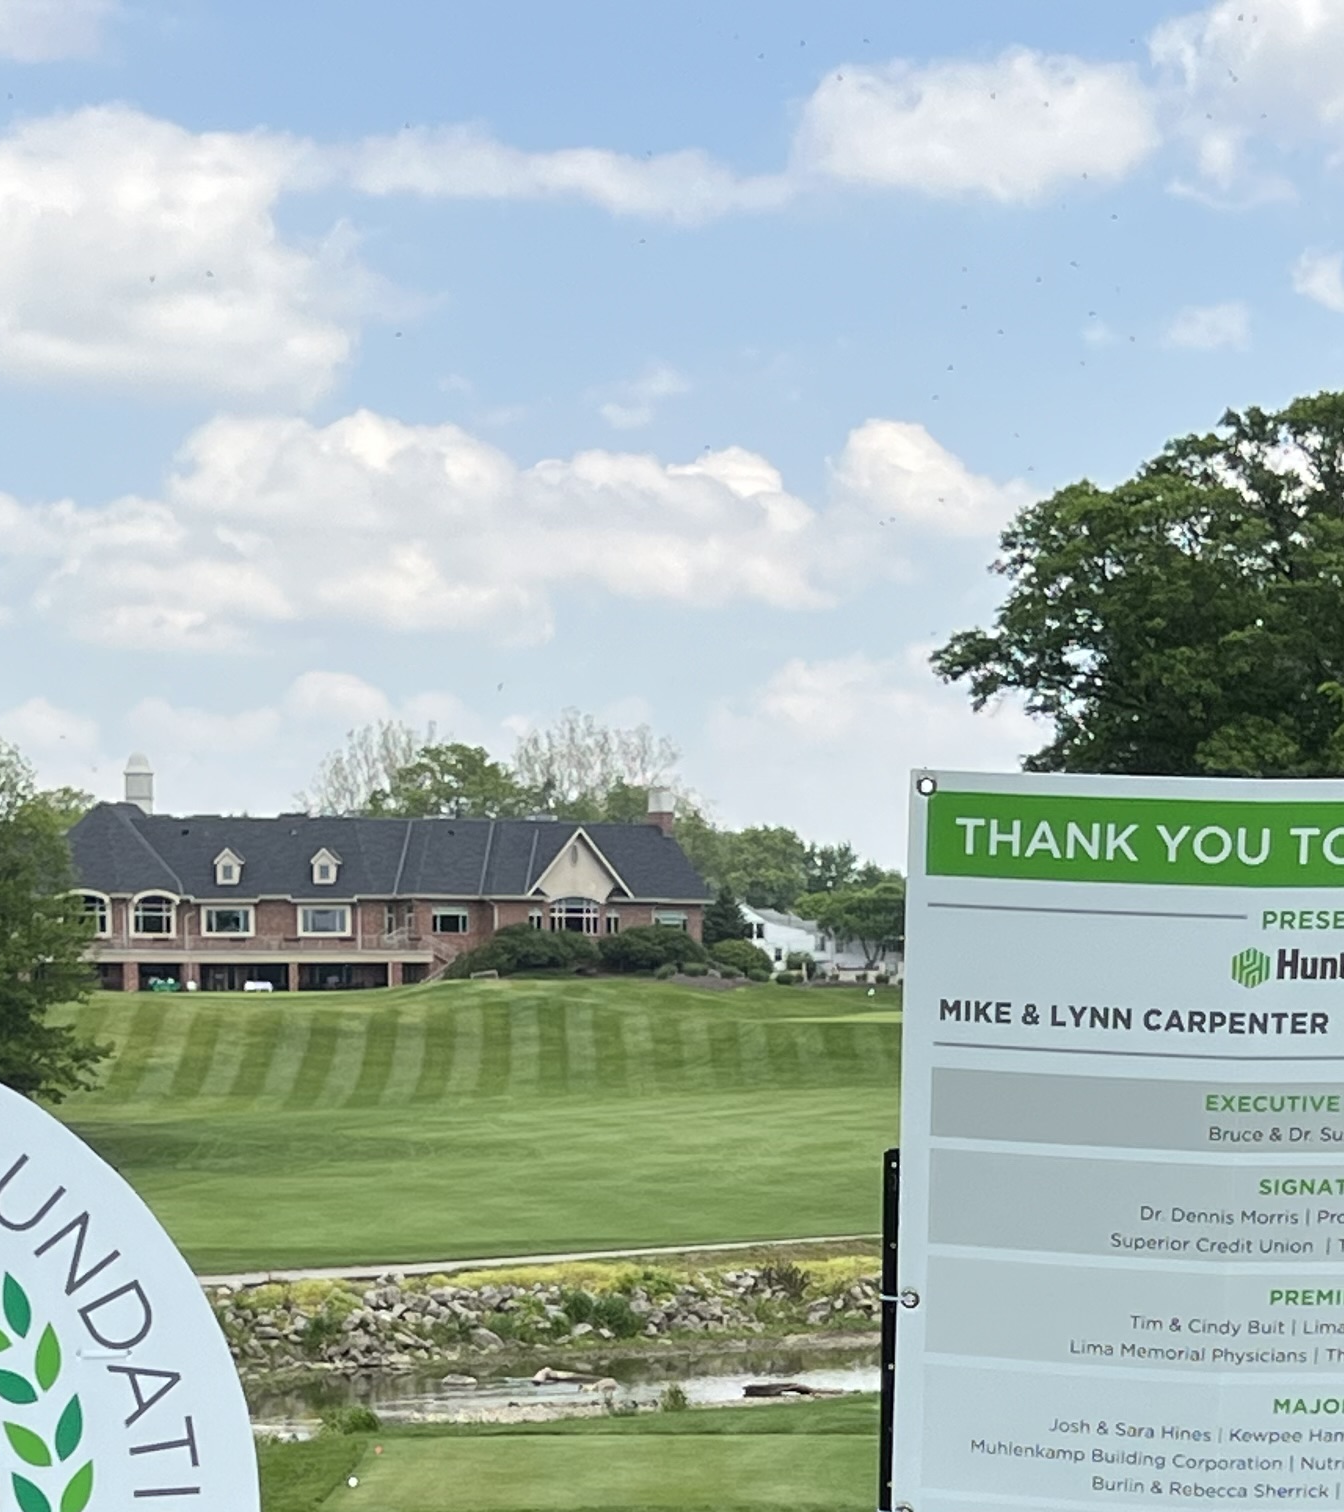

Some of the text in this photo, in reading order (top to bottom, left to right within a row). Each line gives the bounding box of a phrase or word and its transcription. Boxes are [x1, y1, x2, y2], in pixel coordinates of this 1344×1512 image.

[954, 816, 1139, 862] THANK
[1155, 824, 1271, 866] YOU
[939, 998, 1012, 1025] MIKE
[1020, 1002, 1040, 1026] &
[1050, 1004, 1132, 1030] LYNN
[1142, 1008, 1329, 1035] CARPENTER
[1204, 1093, 1341, 1113] EXECUTIVE
[1208, 1125, 1264, 1143] Bruce
[1268, 1126, 1282, 1143] &
[1170, 1206, 1235, 1226] Dennis
[1240, 1209, 1299, 1225] Morris
[1110, 1231, 1191, 1252] Superior
[1195, 1236, 1253, 1254] Credit
[1258, 1238, 1314, 1254] Union
[1129, 1314, 1164, 1331] Tim
[1168, 1316, 1182, 1333] &
[1187, 1318, 1242, 1338] Cindy
[1246, 1319, 1285, 1335] Buit
[1069, 1339, 1114, 1356] Lima
[1120, 1342, 1206, 1362] Memorial
[1211, 1347, 1308, 1366] Physicians
[1048, 1417, 1090, 1434] Josh
[1095, 1420, 1109, 1436] &
[1114, 1421, 1155, 1439] Sara
[1160, 1425, 1212, 1443] Hines
[1228, 1427, 1304, 1445] Kewpee
[970, 1438, 1086, 1464] Muhlenkamp
[1090, 1447, 1166, 1470] Building
[1171, 1452, 1283, 1473] Corporation
[1091, 1474, 1145, 1494] Burlin
[1149, 1479, 1164, 1495] &
[1168, 1480, 1248, 1499] Rebecca
[1253, 1482, 1329, 1499] Sherrick
